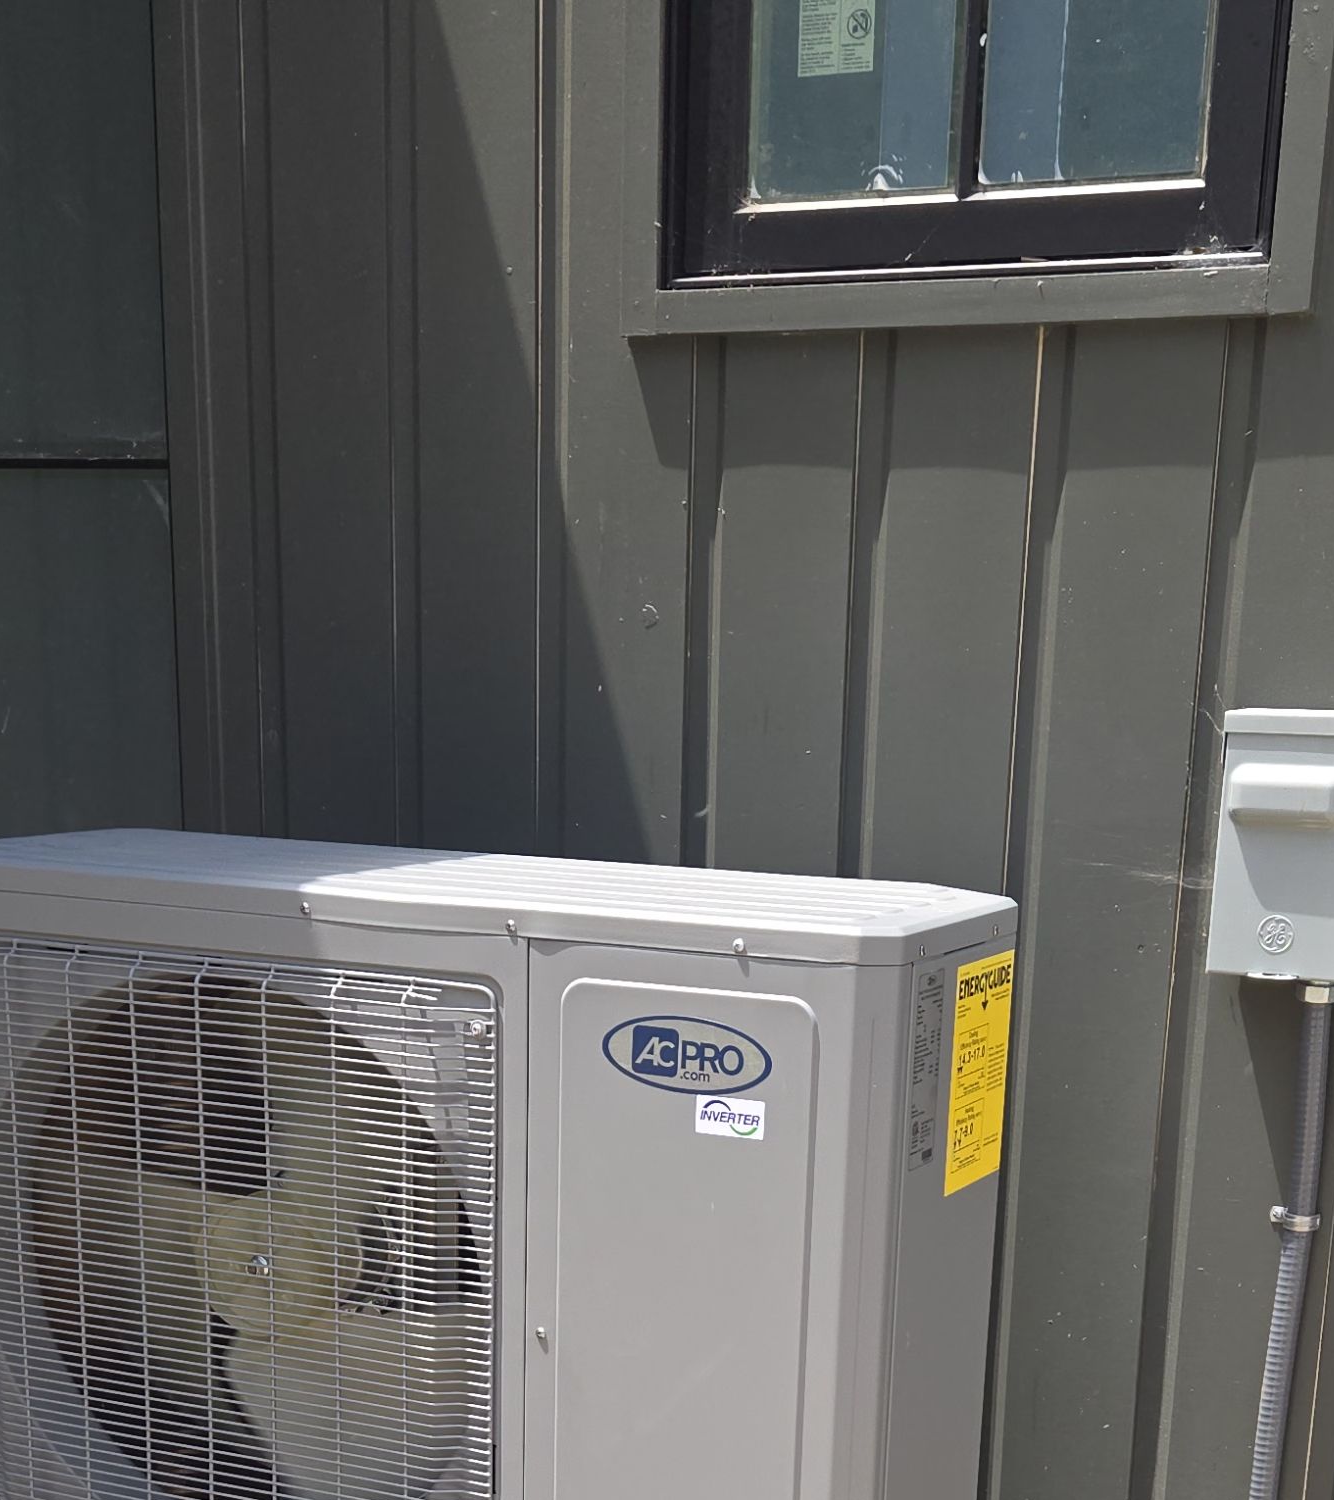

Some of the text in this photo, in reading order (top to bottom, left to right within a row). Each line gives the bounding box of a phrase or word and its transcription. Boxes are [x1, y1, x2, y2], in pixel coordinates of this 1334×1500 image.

[958, 964, 1012, 1001] ENERGYGUIDE
[680, 1070, 711, 1083] .com
[700, 1109, 760, 1127] INVERTER
